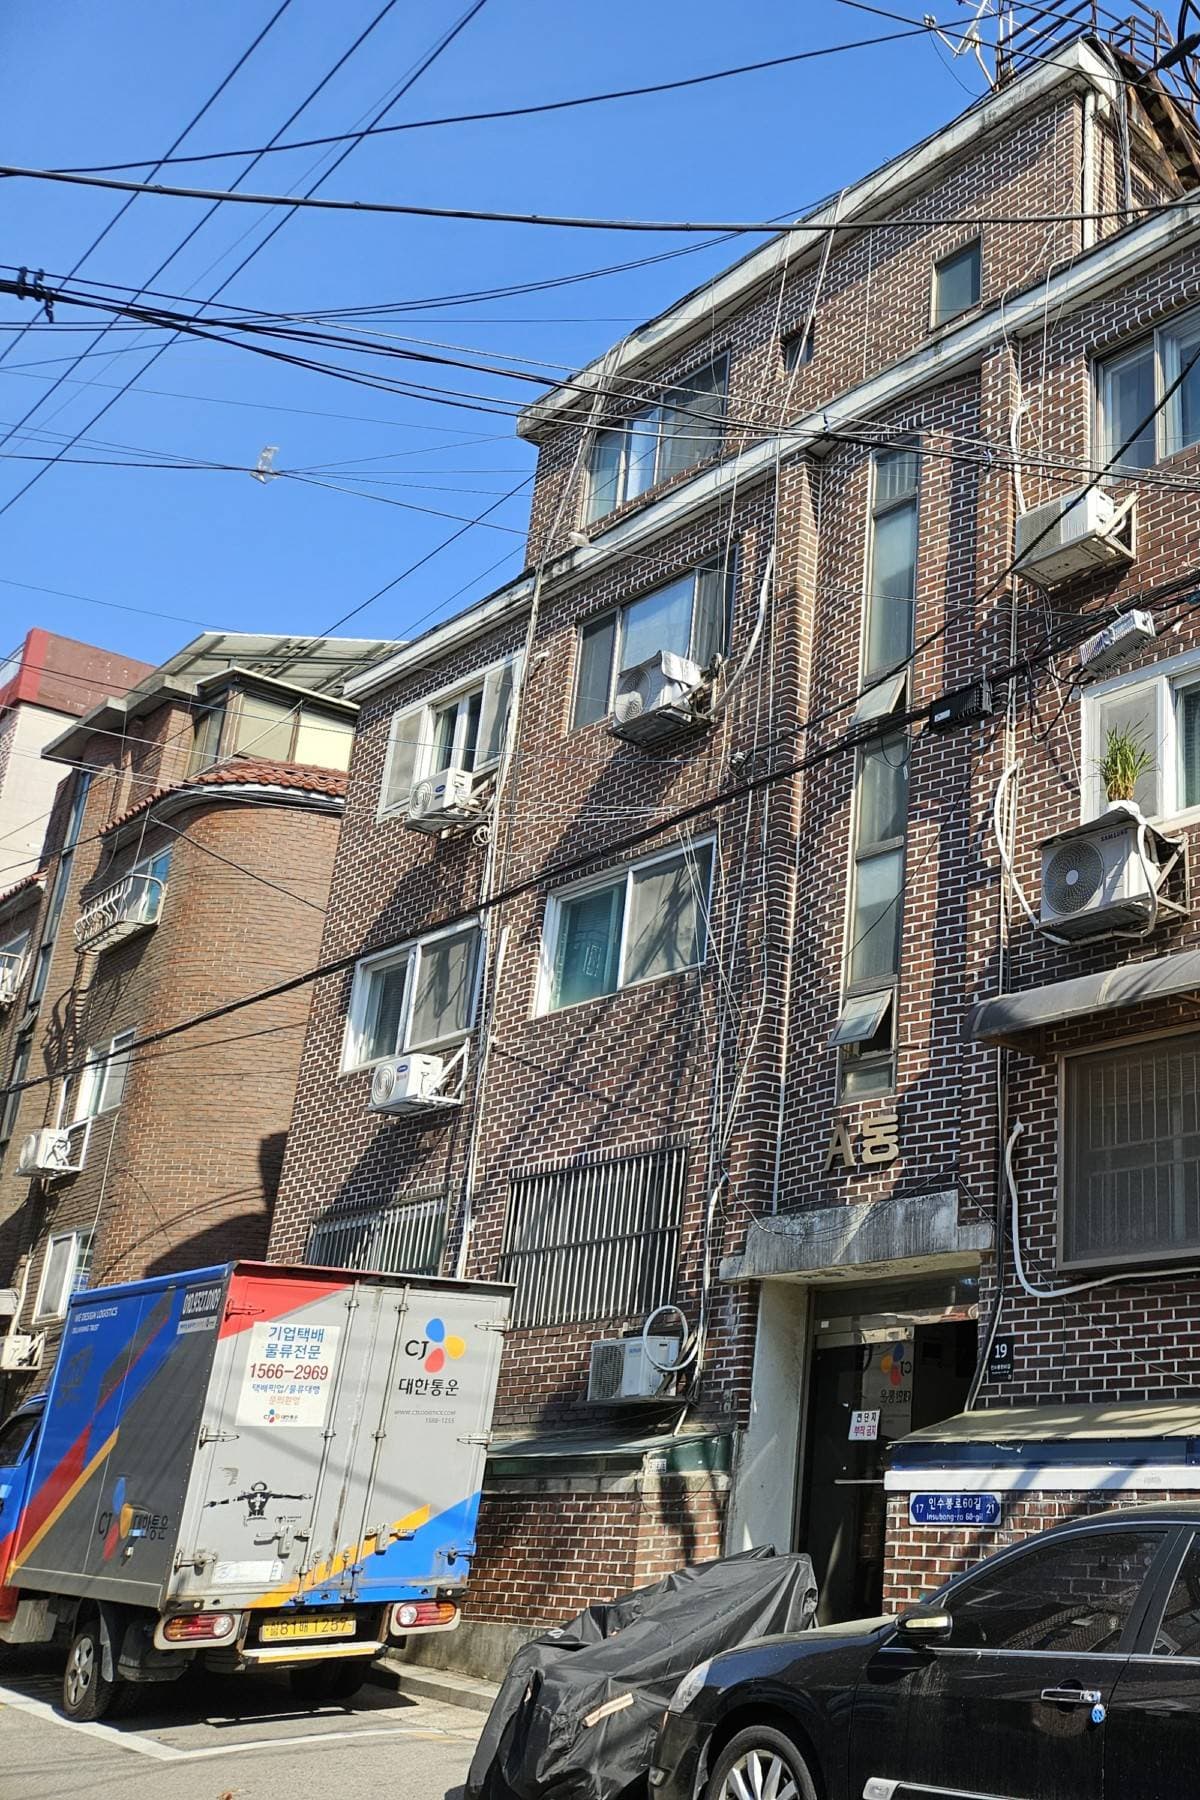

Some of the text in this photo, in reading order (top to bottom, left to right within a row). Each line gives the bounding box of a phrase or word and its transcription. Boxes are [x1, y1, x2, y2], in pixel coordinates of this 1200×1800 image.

[823, 1114, 899, 1171] A동
[268, 1326, 325, 1343] 기업택배
[265, 1343, 321, 1360] 물류전문
[405, 1340, 430, 1360] CJ
[995, 1343, 1008, 1359] 19
[250, 1363, 329, 1380] 1566-2969
[398, 1378, 460, 1397] 대한통운
[915, 1497, 995, 1514] 17 인수봉로60길 21
[98, 1511, 113, 1540] CJ
[926, 1513, 984, 1522] Insubong-ro 60-gil
